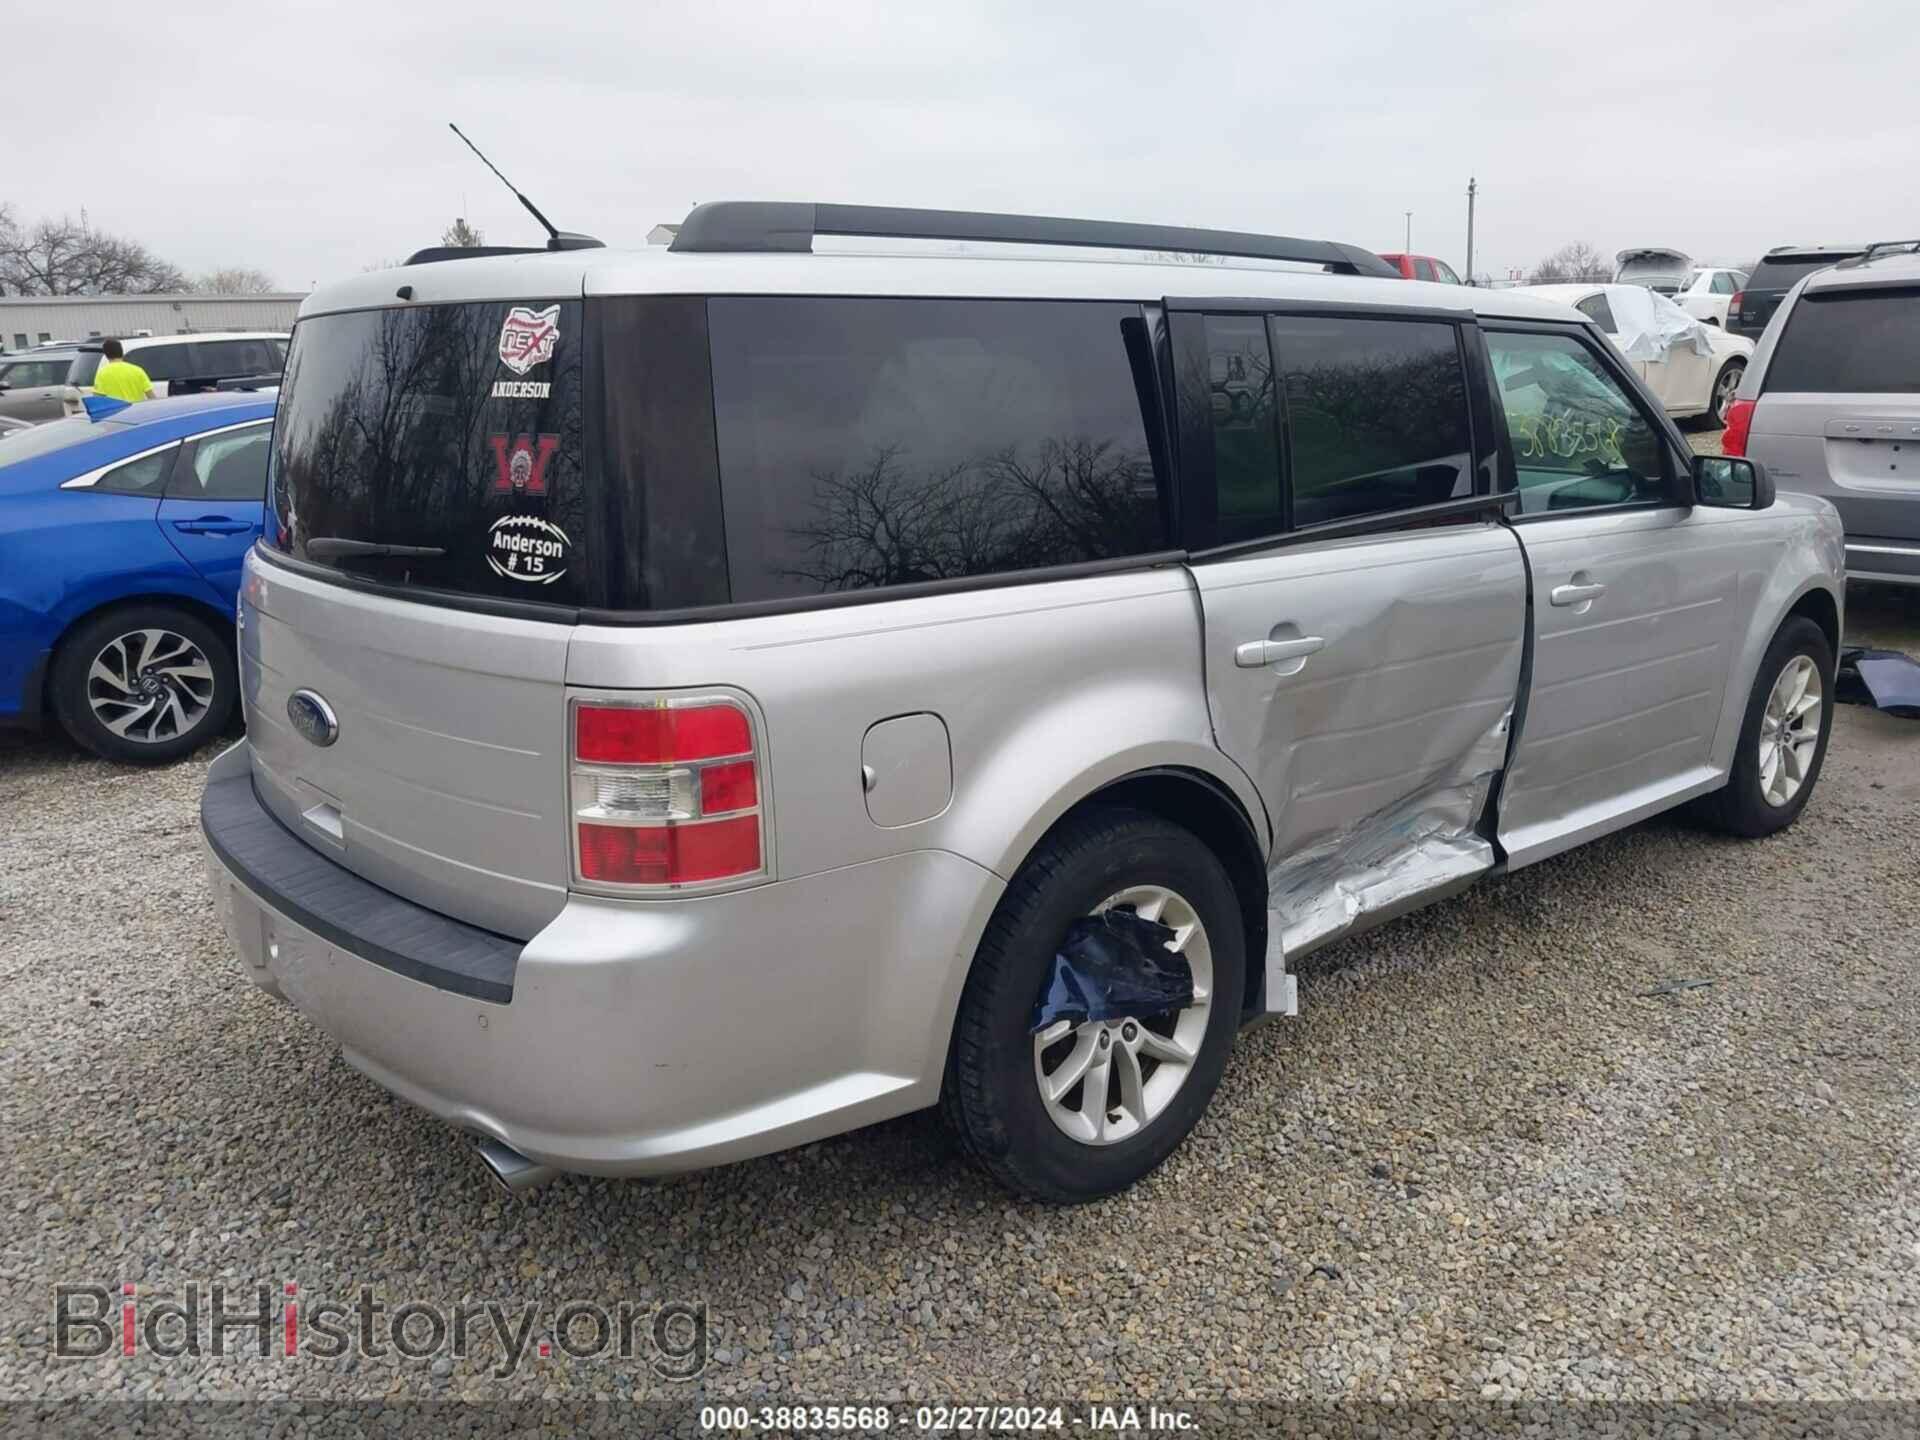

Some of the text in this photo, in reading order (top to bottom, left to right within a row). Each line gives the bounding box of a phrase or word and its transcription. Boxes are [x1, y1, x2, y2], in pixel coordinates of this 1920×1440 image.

[491, 381, 551, 398] ANDERSON
[493, 530, 563, 558] Anderson
[508, 554, 544, 573] # 15
